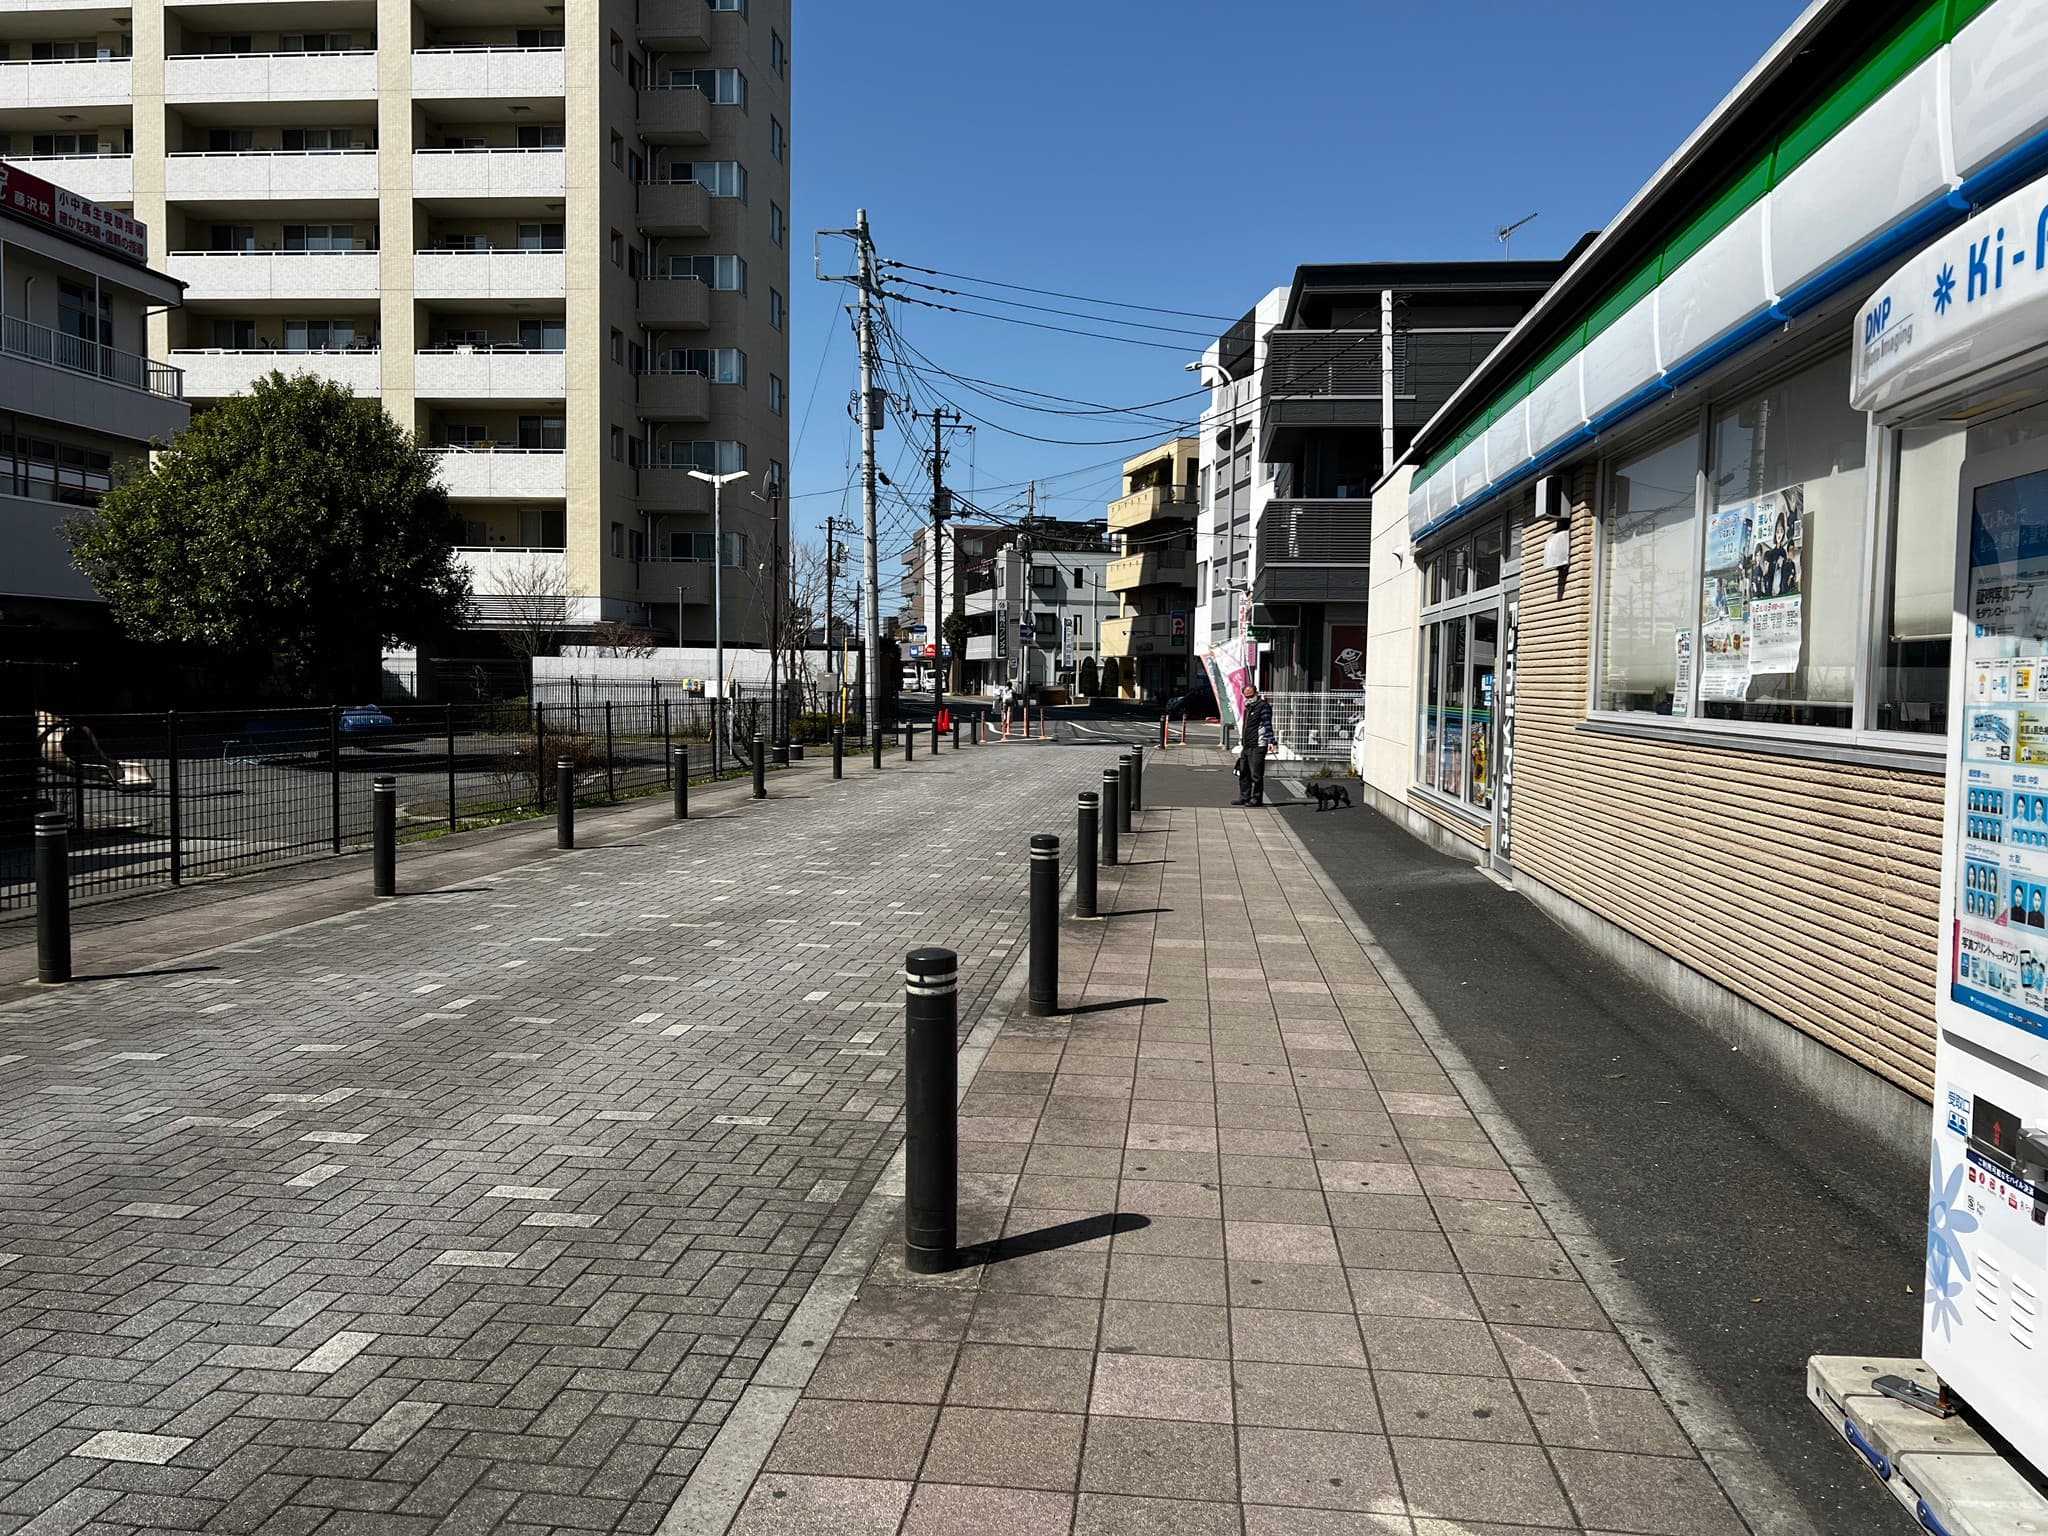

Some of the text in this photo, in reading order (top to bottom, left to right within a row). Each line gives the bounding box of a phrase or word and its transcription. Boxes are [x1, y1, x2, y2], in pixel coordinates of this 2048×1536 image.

[58, 191, 145, 239] 小中高生受験指導
[1865, 295, 1891, 344] DNP
[1881, 323, 1913, 358] Imaging
[1502, 601, 1518, 849] FamilyMart
[1947, 1090, 1970, 1114] 受取口
